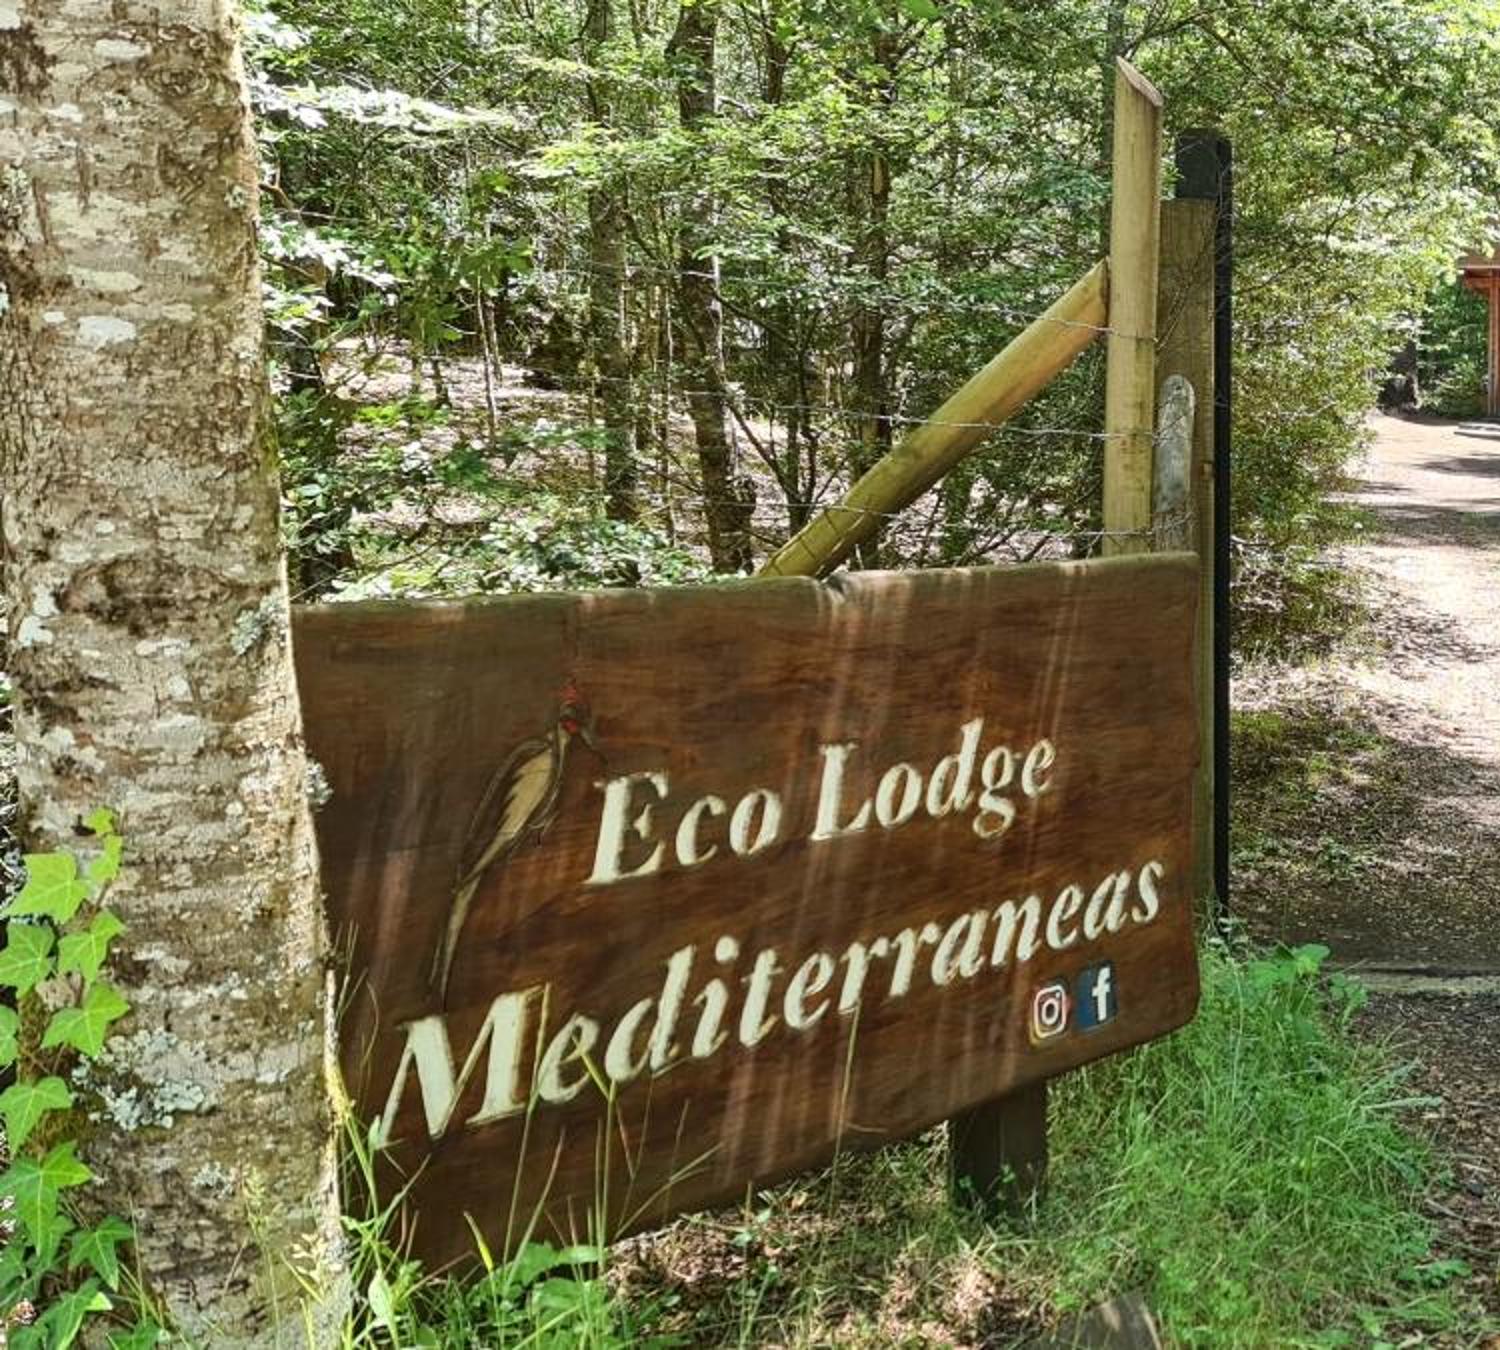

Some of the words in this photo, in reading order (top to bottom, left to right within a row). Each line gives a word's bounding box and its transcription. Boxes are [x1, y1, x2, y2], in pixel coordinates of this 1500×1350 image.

[585, 771, 784, 885] Eco
[810, 717, 1056, 840] Lodge
[374, 859, 1165, 1149] Mediterraneas
